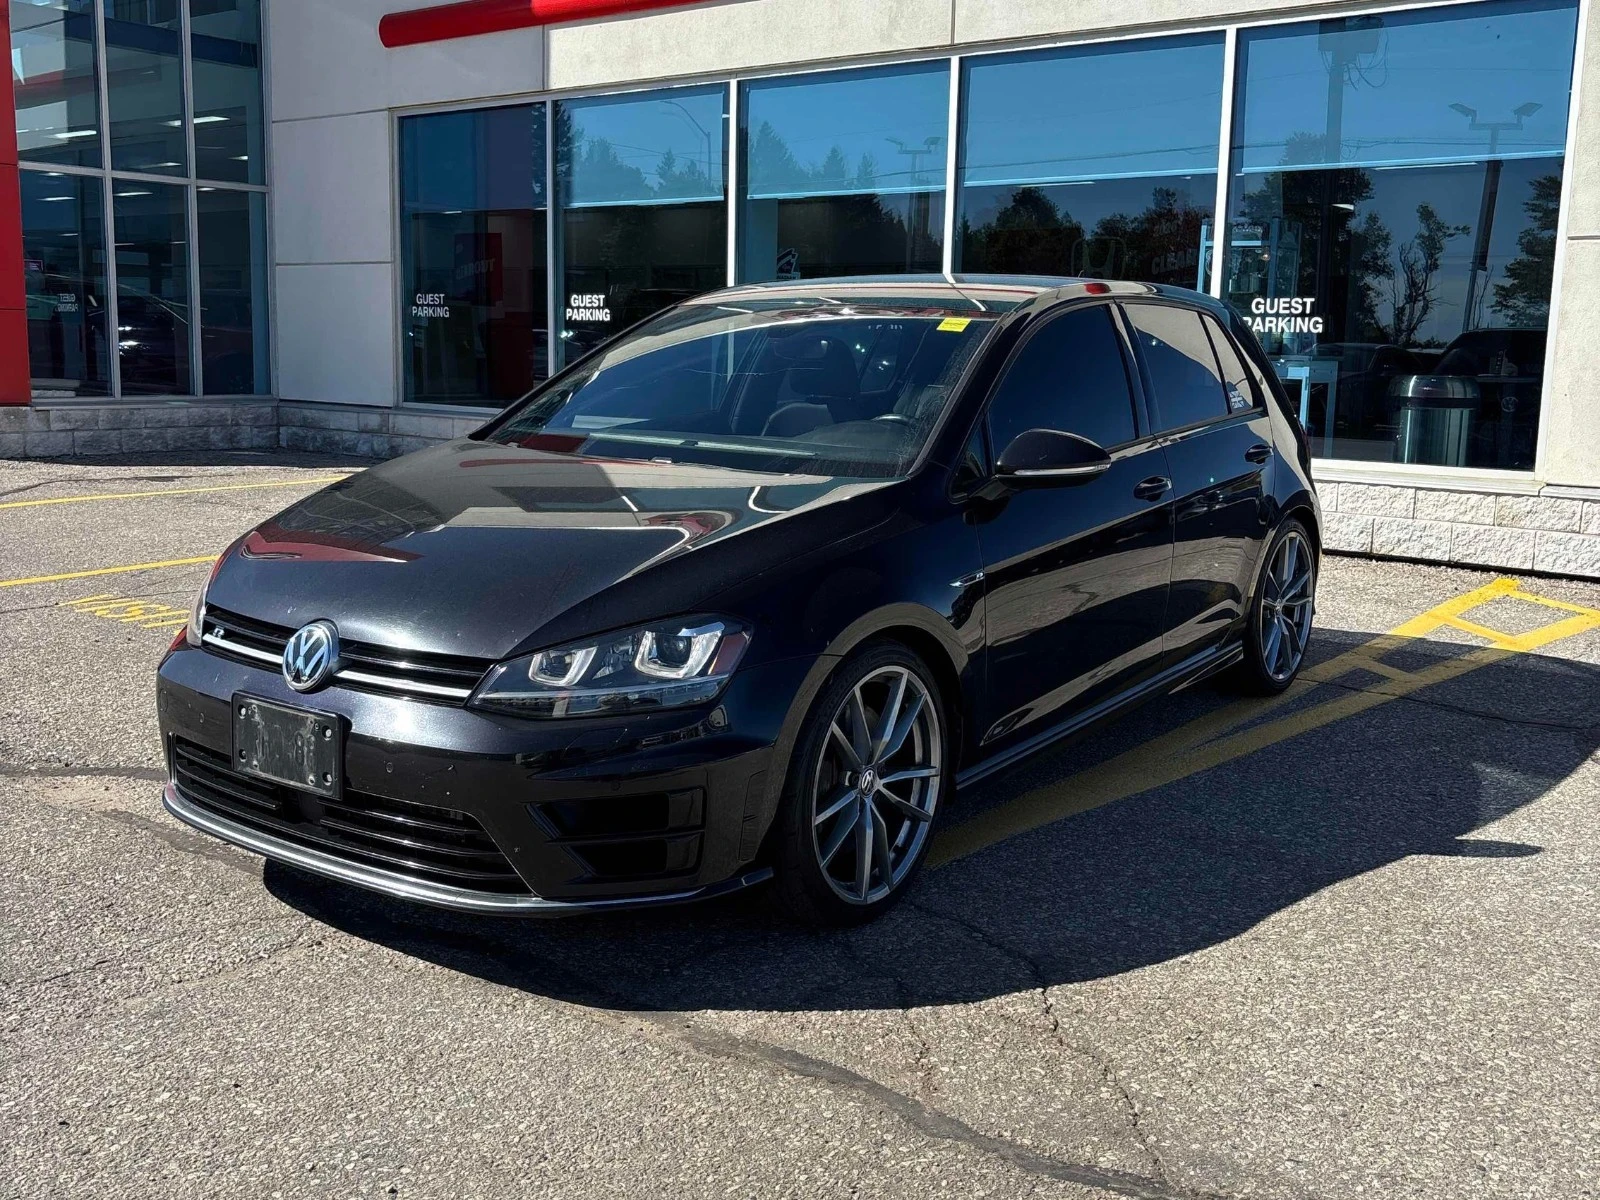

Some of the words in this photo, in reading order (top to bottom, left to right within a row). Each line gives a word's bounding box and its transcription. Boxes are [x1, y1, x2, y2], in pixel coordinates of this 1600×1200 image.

[416, 293, 445, 305] GUEST
[570, 294, 606, 308] GUEST
[412, 306, 450, 318] PARKING
[1251, 297, 1316, 315] GUEST
[566, 308, 611, 321] PARKING
